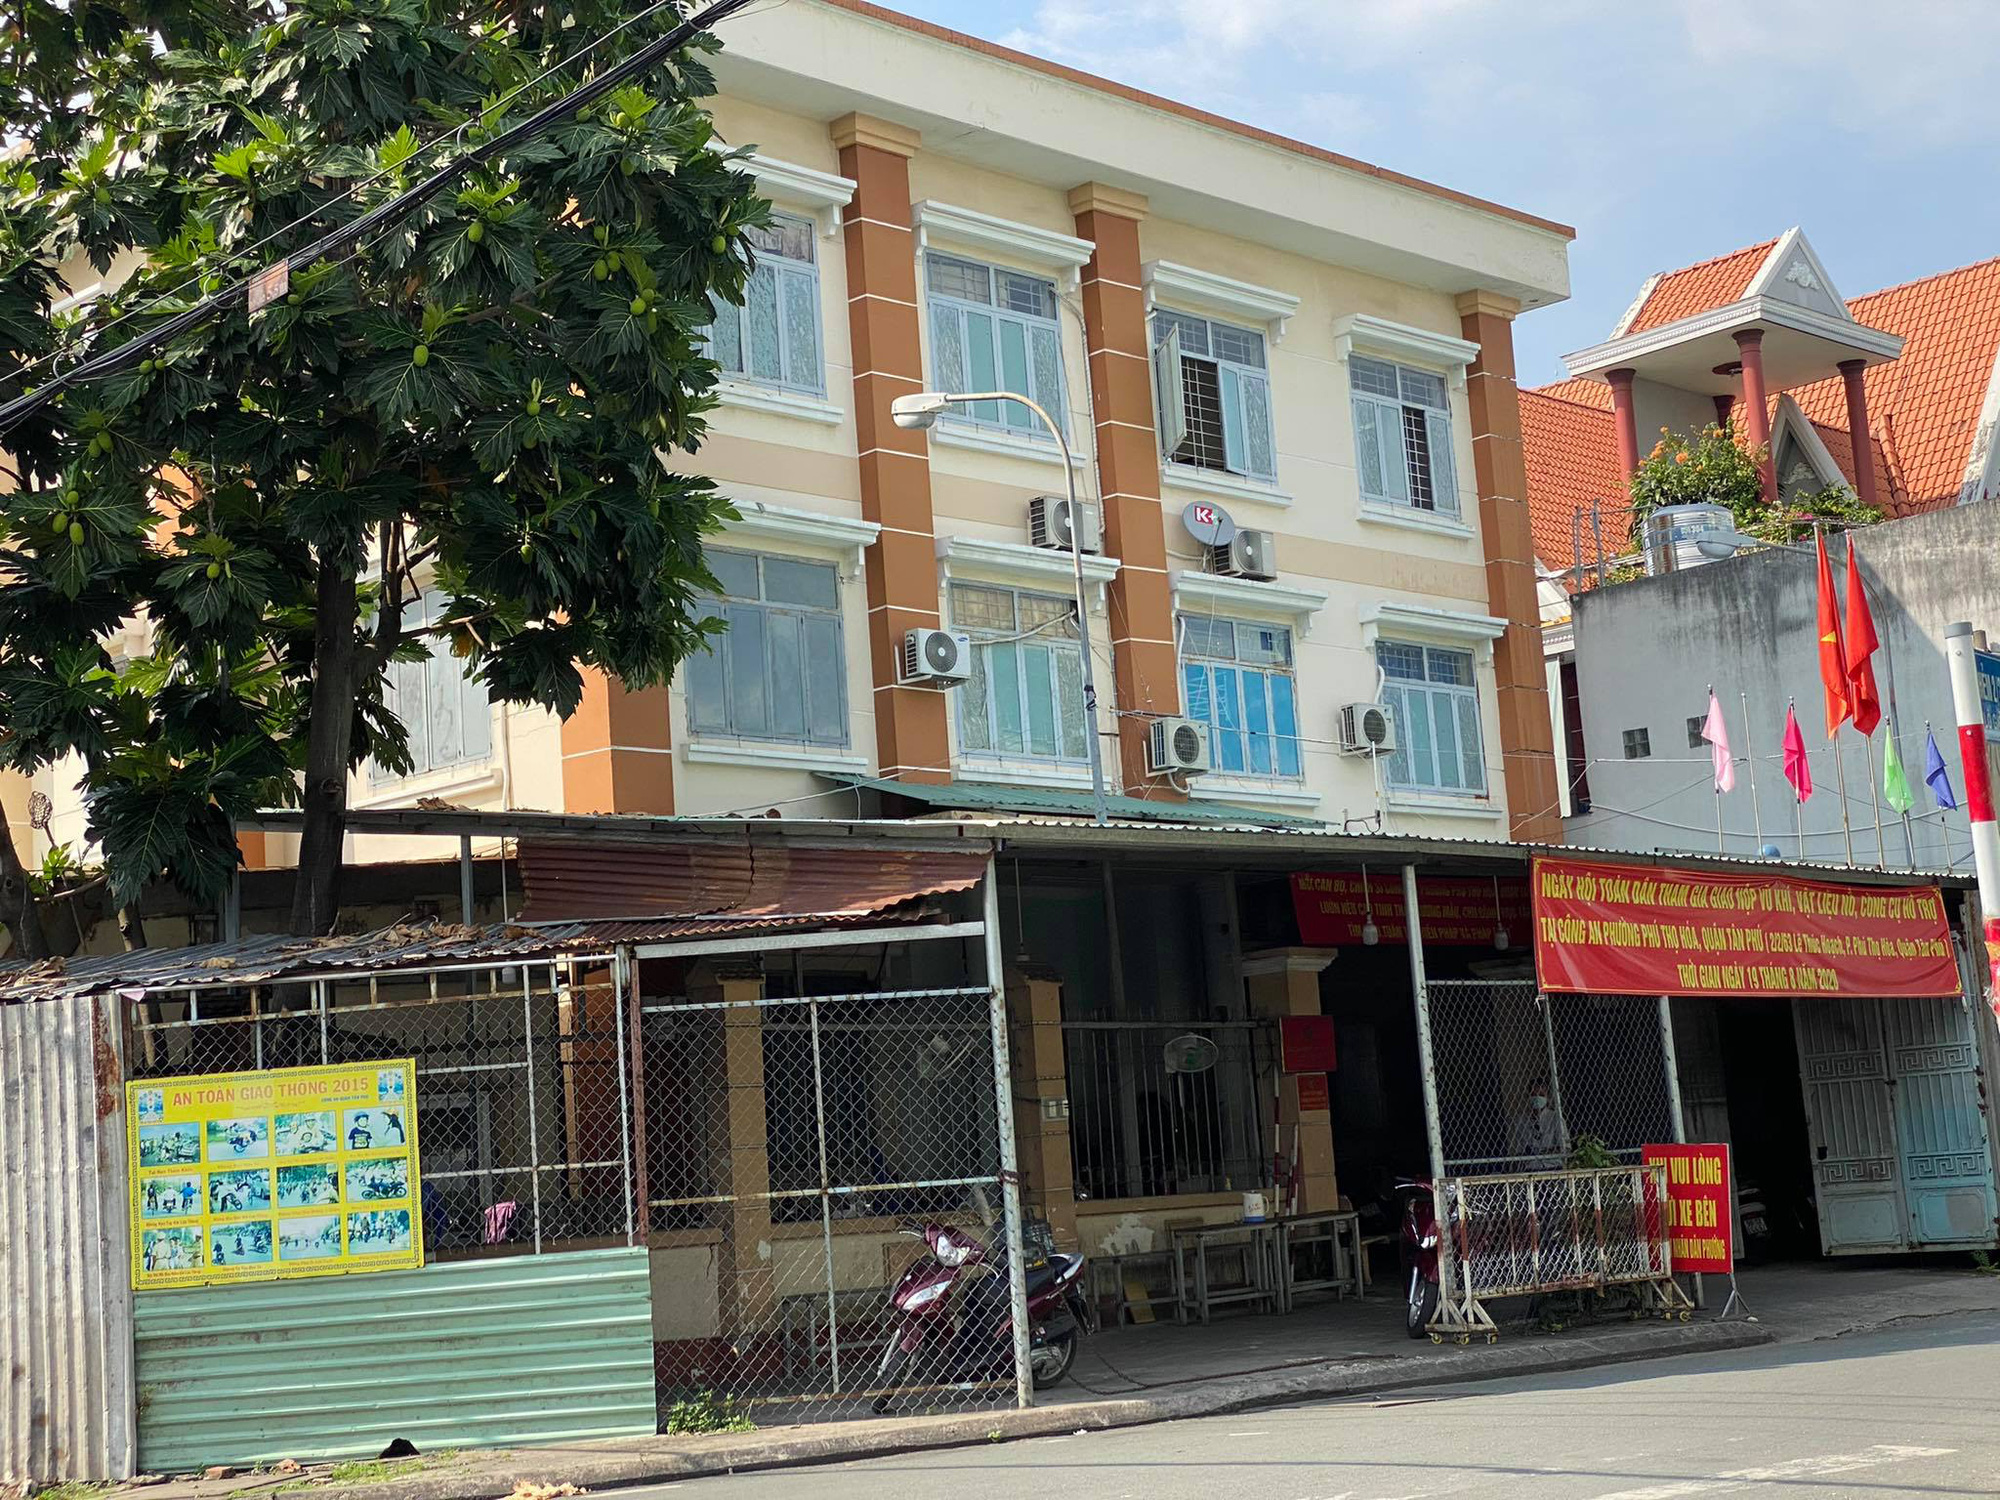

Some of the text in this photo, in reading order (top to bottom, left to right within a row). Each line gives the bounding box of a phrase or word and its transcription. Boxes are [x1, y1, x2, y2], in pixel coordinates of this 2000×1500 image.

[1541, 869, 1573, 899] NGÀY
[1576, 872, 1597, 906] HỘI
[1599, 875, 1630, 904] TOÀN
[1631, 877, 1657, 906] DÂN
[1658, 883, 1690, 907] THAM
[1690, 885, 1709, 908] GIA
[1710, 885, 1735, 909] GIAO
[1736, 883, 1757, 915] NỘP
[1759, 884, 1773, 911] VŨ
[1774, 885, 1796, 914] KHÍ,
[1796, 886, 1815, 918] VẬT
[1817, 889, 1840, 920] LIỆU
[1888, 896, 1901, 924] CỤ
[1916, 897, 1938, 925] TRỢ
[1540, 917, 1557, 948] TẠI
[1558, 913, 1586, 944] CÔNG
[1588, 920, 1603, 945] AN
[1603, 916, 1641, 948] PHƯỜNG
[1641, 919, 1661, 949] PHÚ
[1660, 924, 1680, 954] THỌ
[1702, 922, 1727, 956] QUẬN
[1726, 923, 1745, 952] TÂN
[1745, 923, 1764, 952] PHÚ
[1793, 932, 1803, 953] Lê
[1677, 958, 1699, 988] THỜI
[1699, 964, 1721, 989] GIAN
[1722, 960, 1745, 989] NGÀY
[1747, 967, 1760, 990] 19
[1759, 961, 1789, 990] THÁNG
[1788, 967, 1797, 990] 8
[1796, 962, 1818, 990] NĂM
[173, 1077, 369, 1106] AN TOÀN GIAO THÔNG 2015
[1670, 1156, 1690, 1184] VUI
[1692, 1152, 1722, 1185] LÒNG
[1679, 1199, 1693, 1227] XE
[1695, 1194, 1717, 1228] BÊN
[1689, 1234, 1702, 1259] DÂN
[1702, 1233, 1726, 1260] PHƯỜNG
